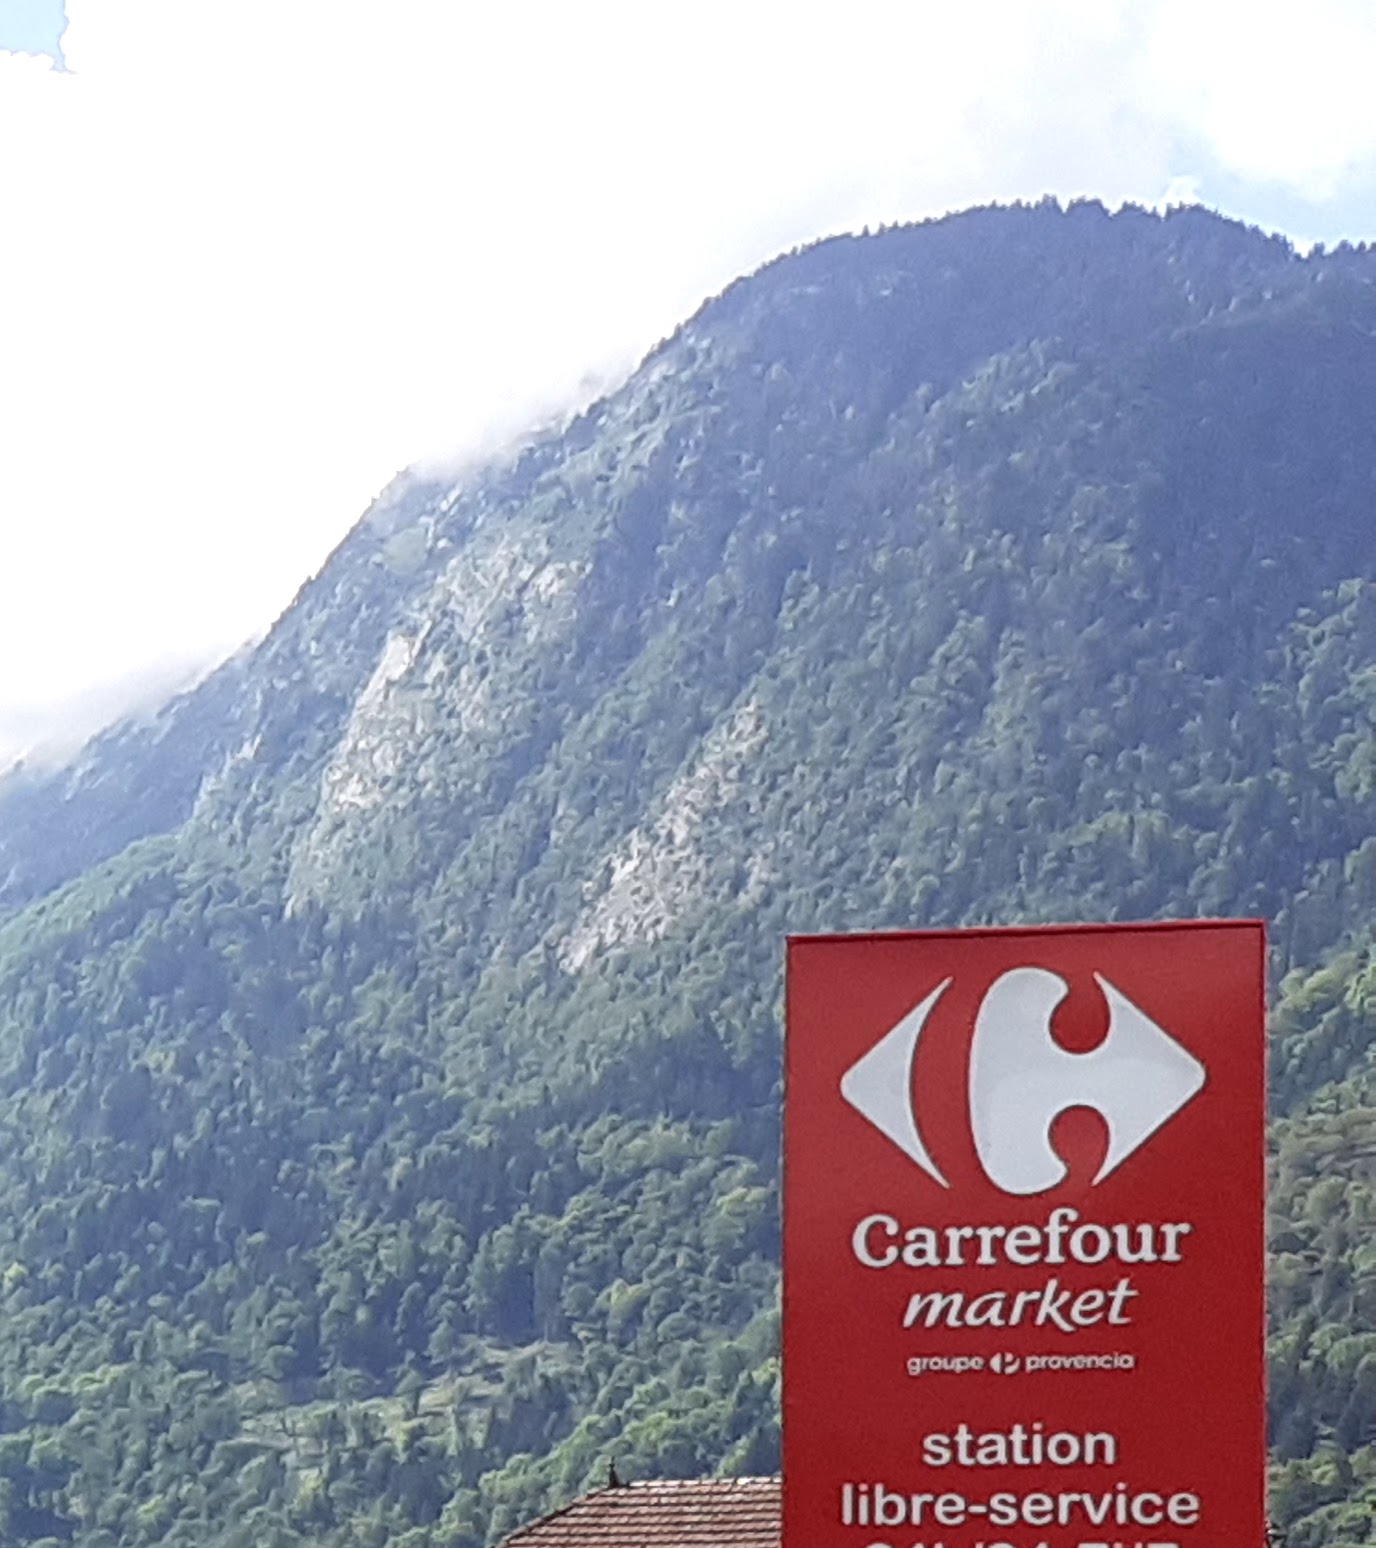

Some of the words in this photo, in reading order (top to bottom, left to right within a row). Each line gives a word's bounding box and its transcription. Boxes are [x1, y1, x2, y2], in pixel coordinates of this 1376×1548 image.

[852, 1207, 1191, 1268] Carrefour
[903, 1278, 1138, 1332] market
[906, 1356, 985, 1377] groupe
[1024, 1351, 1136, 1374] provencia
[923, 1422, 1115, 1466] station
[842, 1482, 1200, 1526] libre-service
